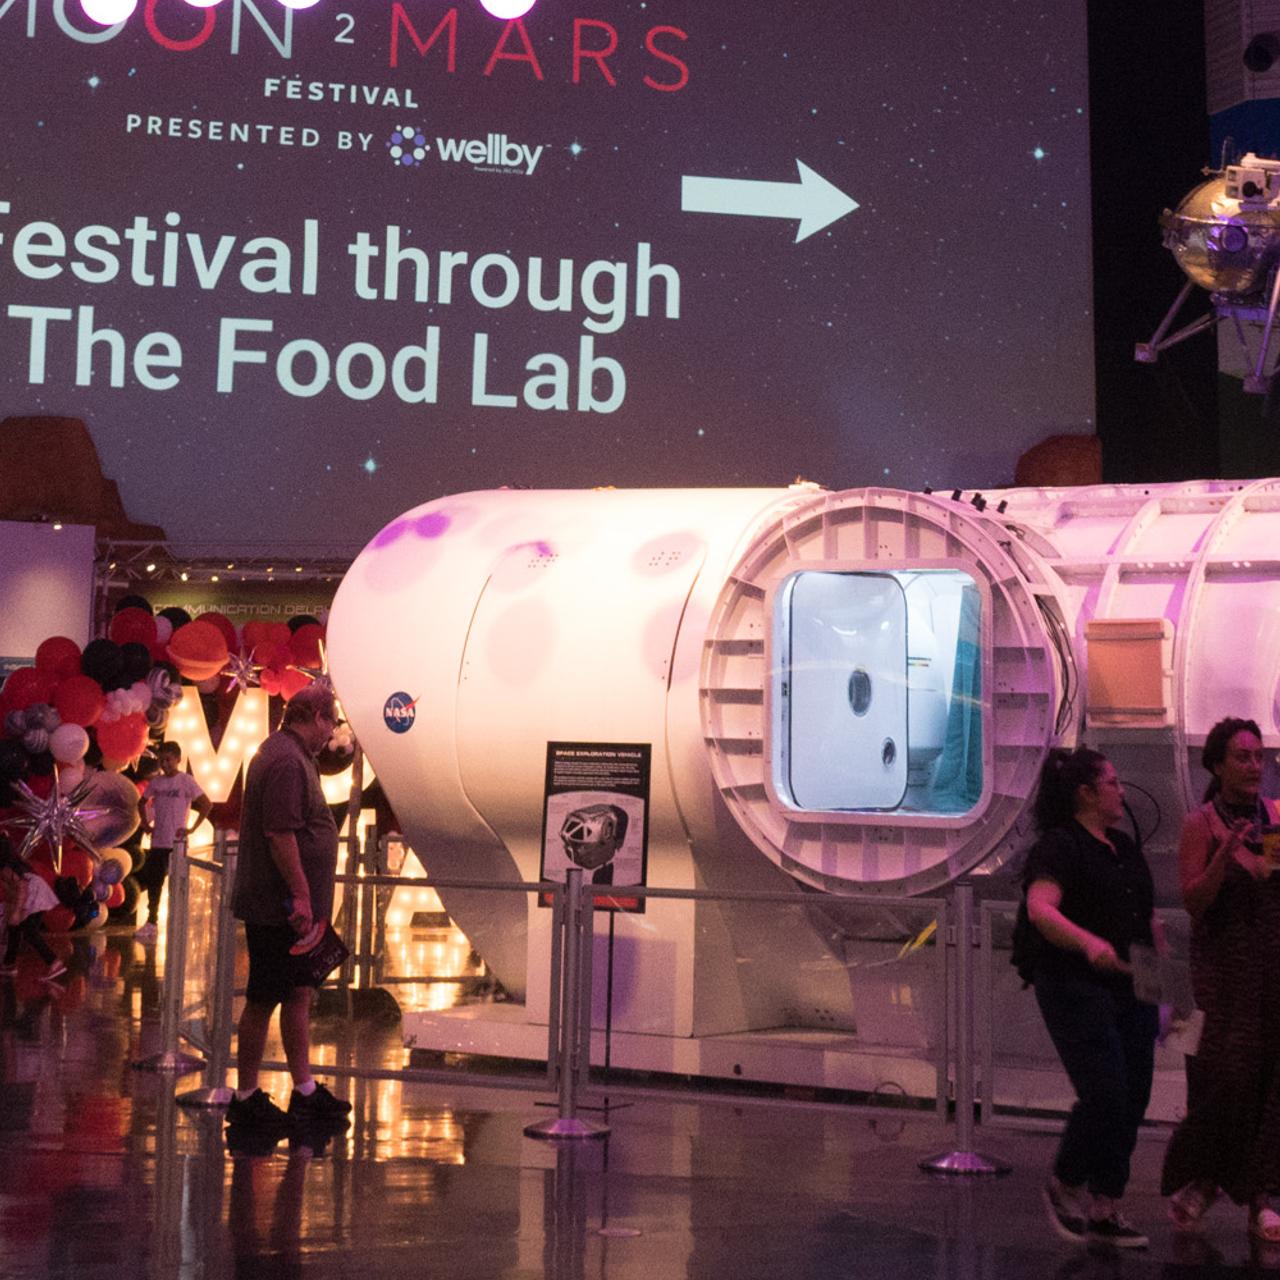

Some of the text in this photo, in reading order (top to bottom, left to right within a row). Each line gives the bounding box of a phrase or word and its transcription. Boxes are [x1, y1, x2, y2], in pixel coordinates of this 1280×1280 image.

[333, 12, 356, 45] 2
[389, 2, 689, 92] MARS
[264, 77, 419, 108] FESTIVAL
[126, 114, 543, 175] PRESENTED BY wellby
[347, 225, 681, 334] through
[7, 304, 627, 414] The Food Lab
[285, 604, 330, 616] DELA
[385, 707, 415, 718] NASA
